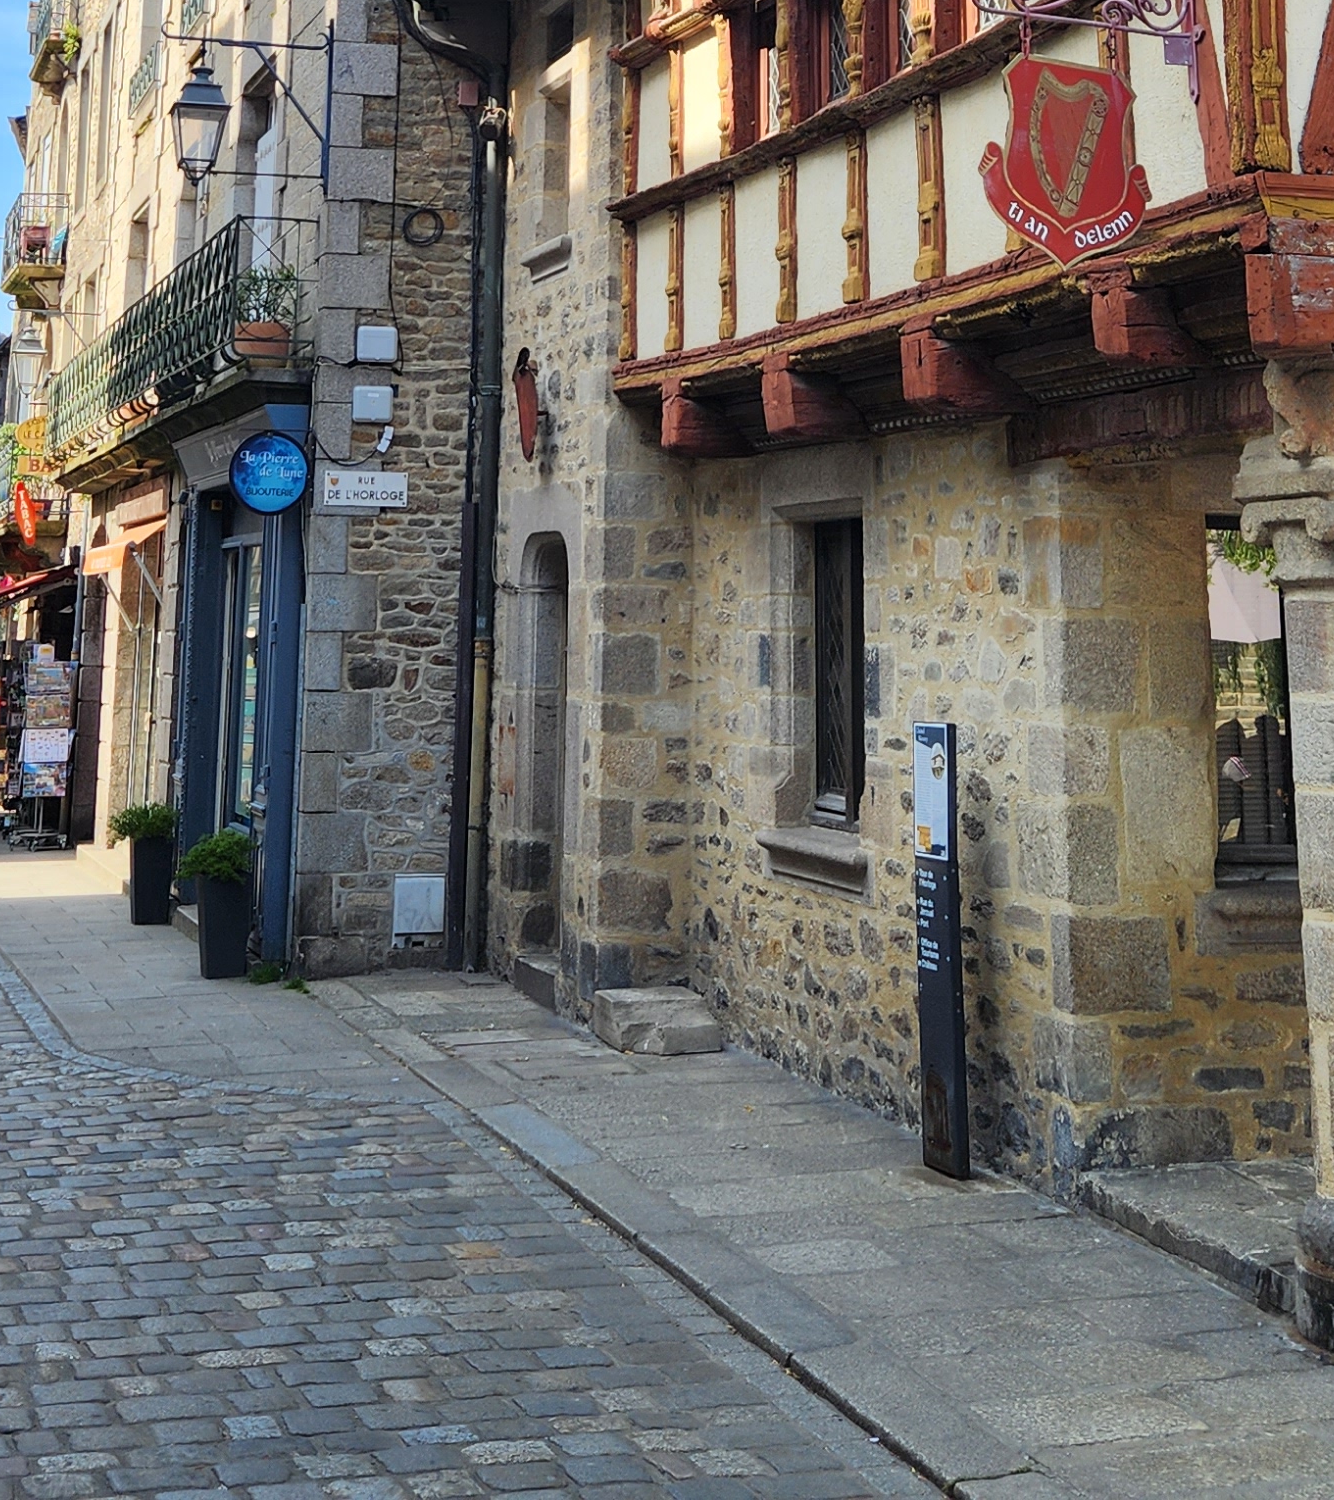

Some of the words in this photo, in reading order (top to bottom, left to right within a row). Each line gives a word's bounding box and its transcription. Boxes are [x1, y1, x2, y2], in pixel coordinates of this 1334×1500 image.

[1025, 216, 1049, 242] an
[1074, 210, 1134, 249] delenn
[28, 459, 52, 473] BA
[239, 450, 257, 467] La
[258, 451, 299, 467] Pierre
[259, 465, 273, 477] de
[276, 466, 304, 482] Lune
[358, 476, 375, 485] RUE
[246, 487, 295, 497] BIJOUTERIE
[328, 490, 341, 500] DE
[346, 489, 404, 501] L'HORLOGE
[18, 490, 34, 539] TABAC
